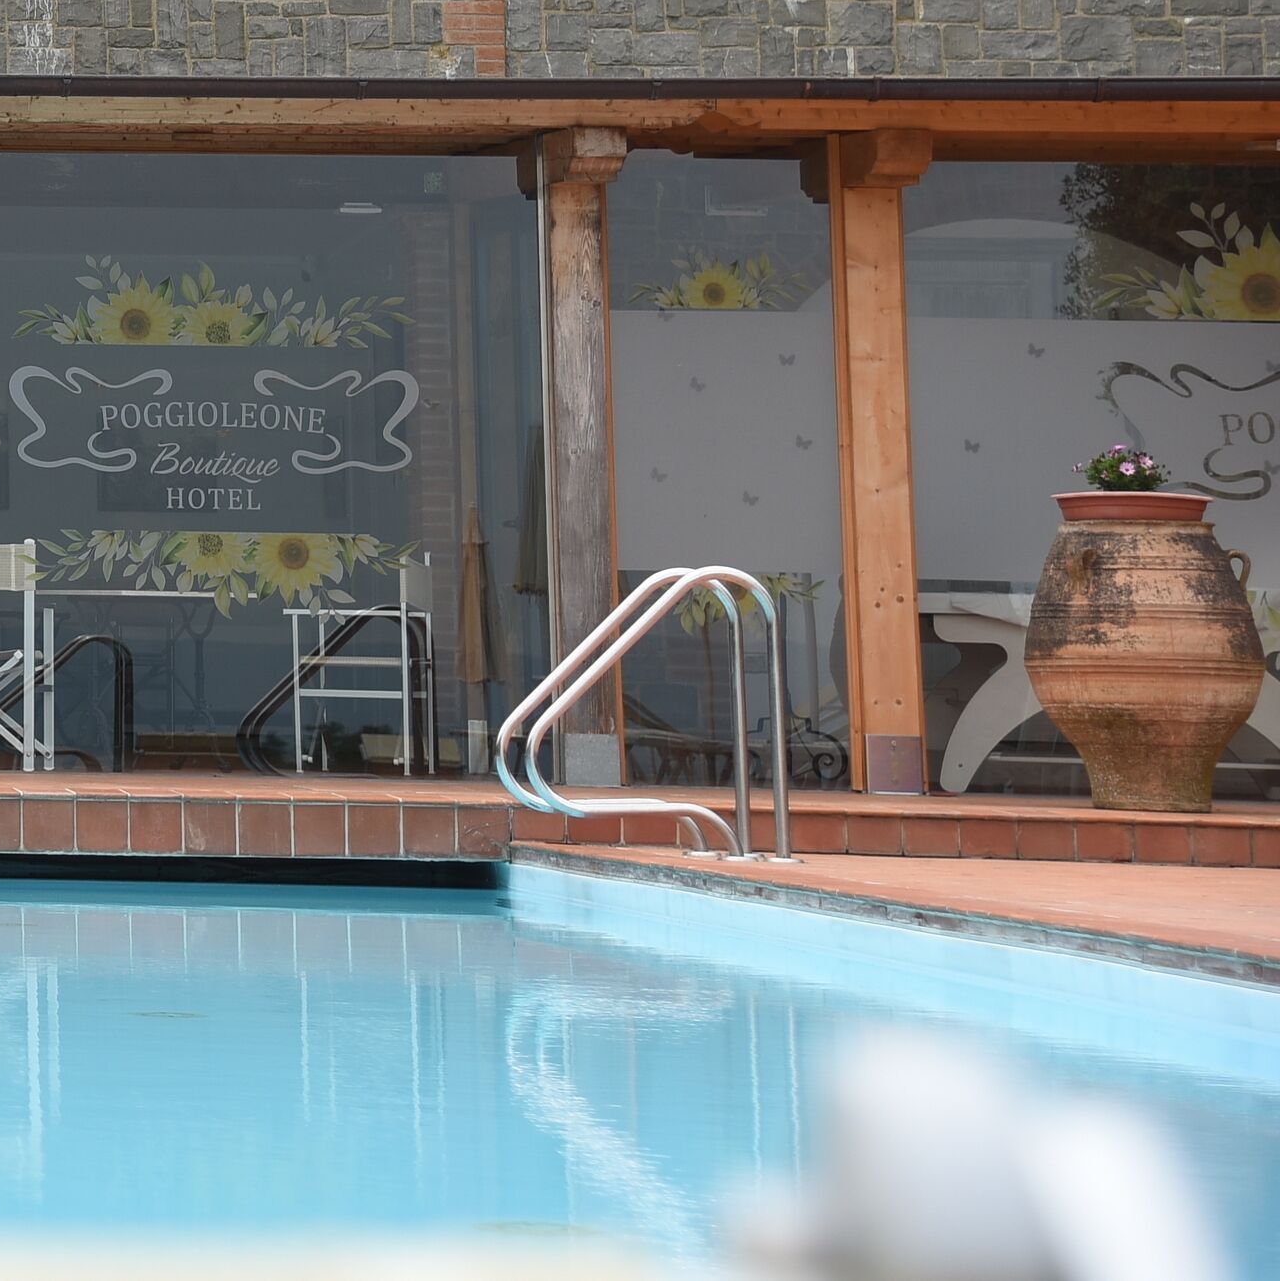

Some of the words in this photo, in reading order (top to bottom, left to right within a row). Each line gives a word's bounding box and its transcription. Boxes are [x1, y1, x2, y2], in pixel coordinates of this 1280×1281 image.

[100, 401, 326, 434] POGGIOLEONE
[1218, 411, 1280, 446] PO
[150, 442, 280, 483] Boutique
[166, 487, 262, 511] HOTEL
